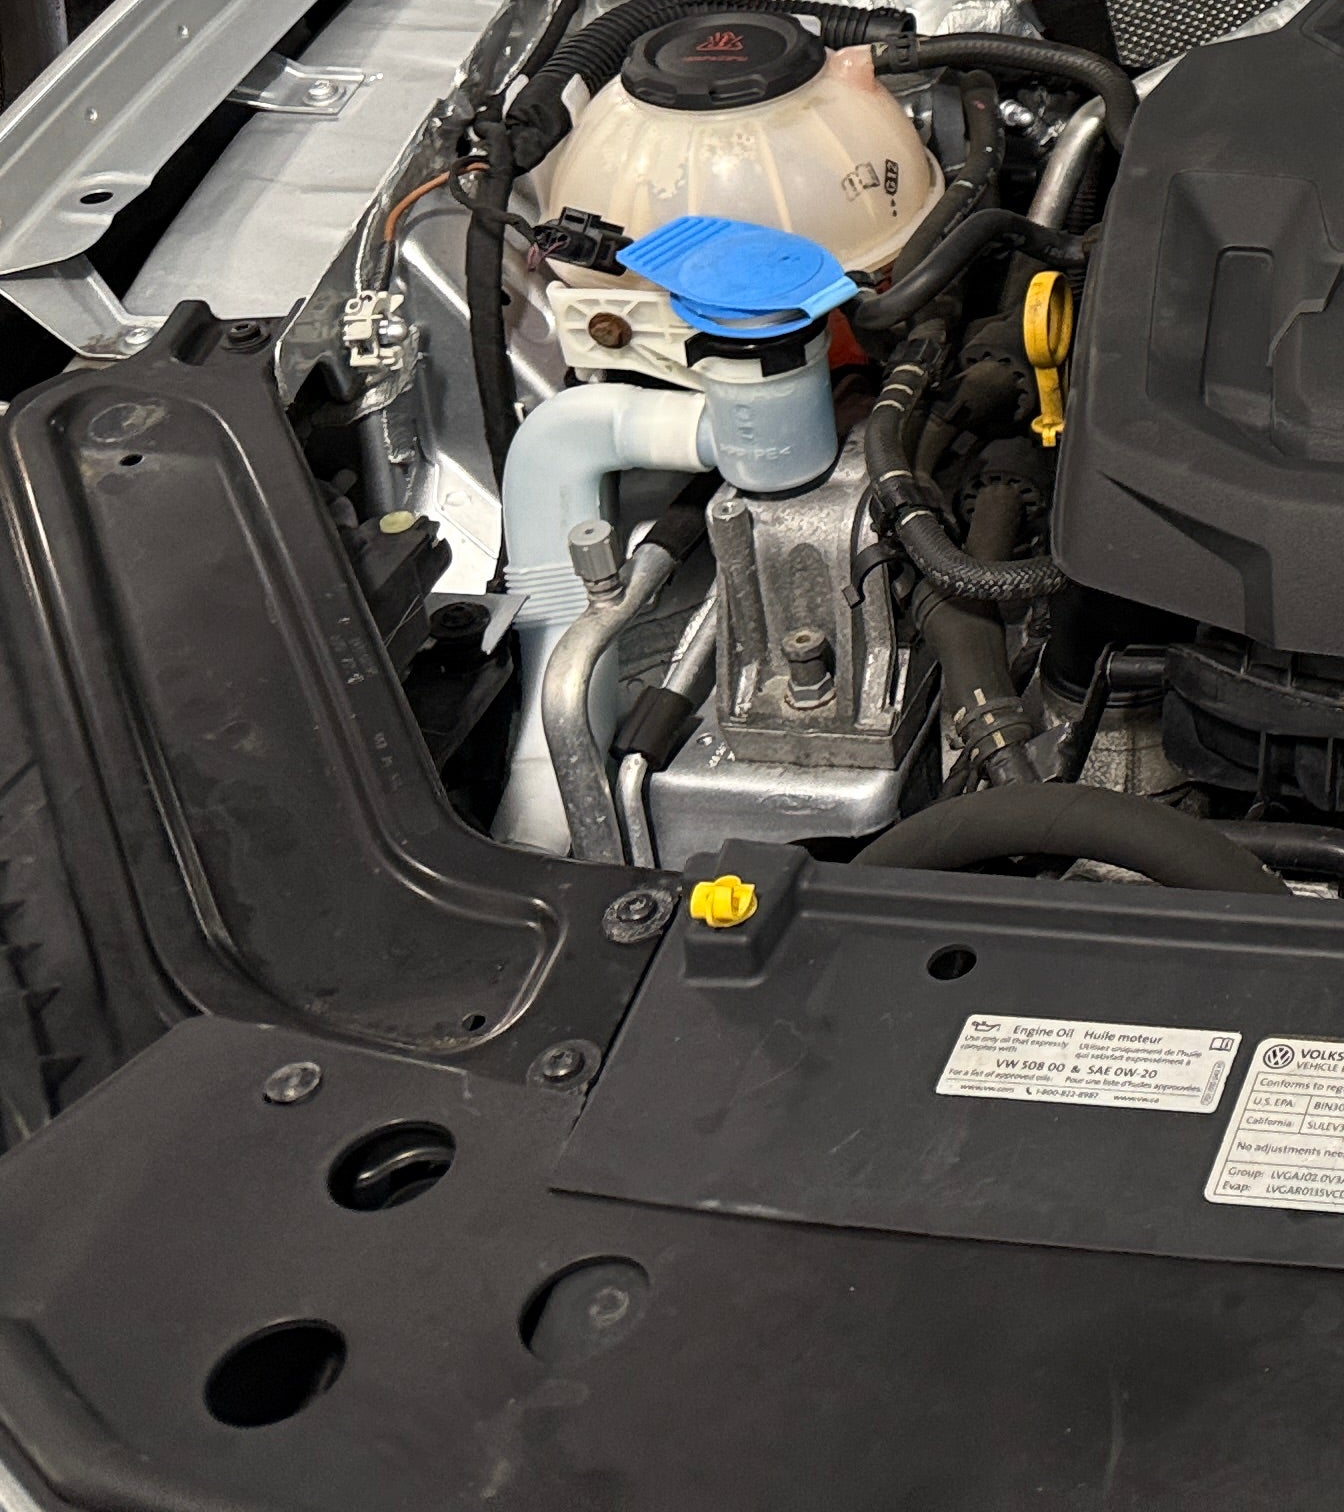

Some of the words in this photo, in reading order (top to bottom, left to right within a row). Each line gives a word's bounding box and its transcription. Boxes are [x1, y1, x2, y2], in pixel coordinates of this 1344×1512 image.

[885, 161, 897, 192] G12
[1011, 1024, 1055, 1038] Engine
[1055, 1027, 1075, 1037] Oil
[1083, 1030, 1116, 1040] Huile
[1117, 1033, 1162, 1044] moteur
[994, 1059, 1019, 1068] VW
[1020, 1060, 1045, 1070] 508
[1047, 1062, 1066, 1071] 00
[1070, 1064, 1081, 1072] &
[1086, 1065, 1112, 1075] SAE
[1295, 1060, 1339, 1072] VEHICLE
[1259, 1077, 1311, 1089] Conforms
[1312, 1081, 1325, 1090] to
[1235, 1140, 1253, 1150] No
[1253, 1142, 1322, 1158] adjustments
